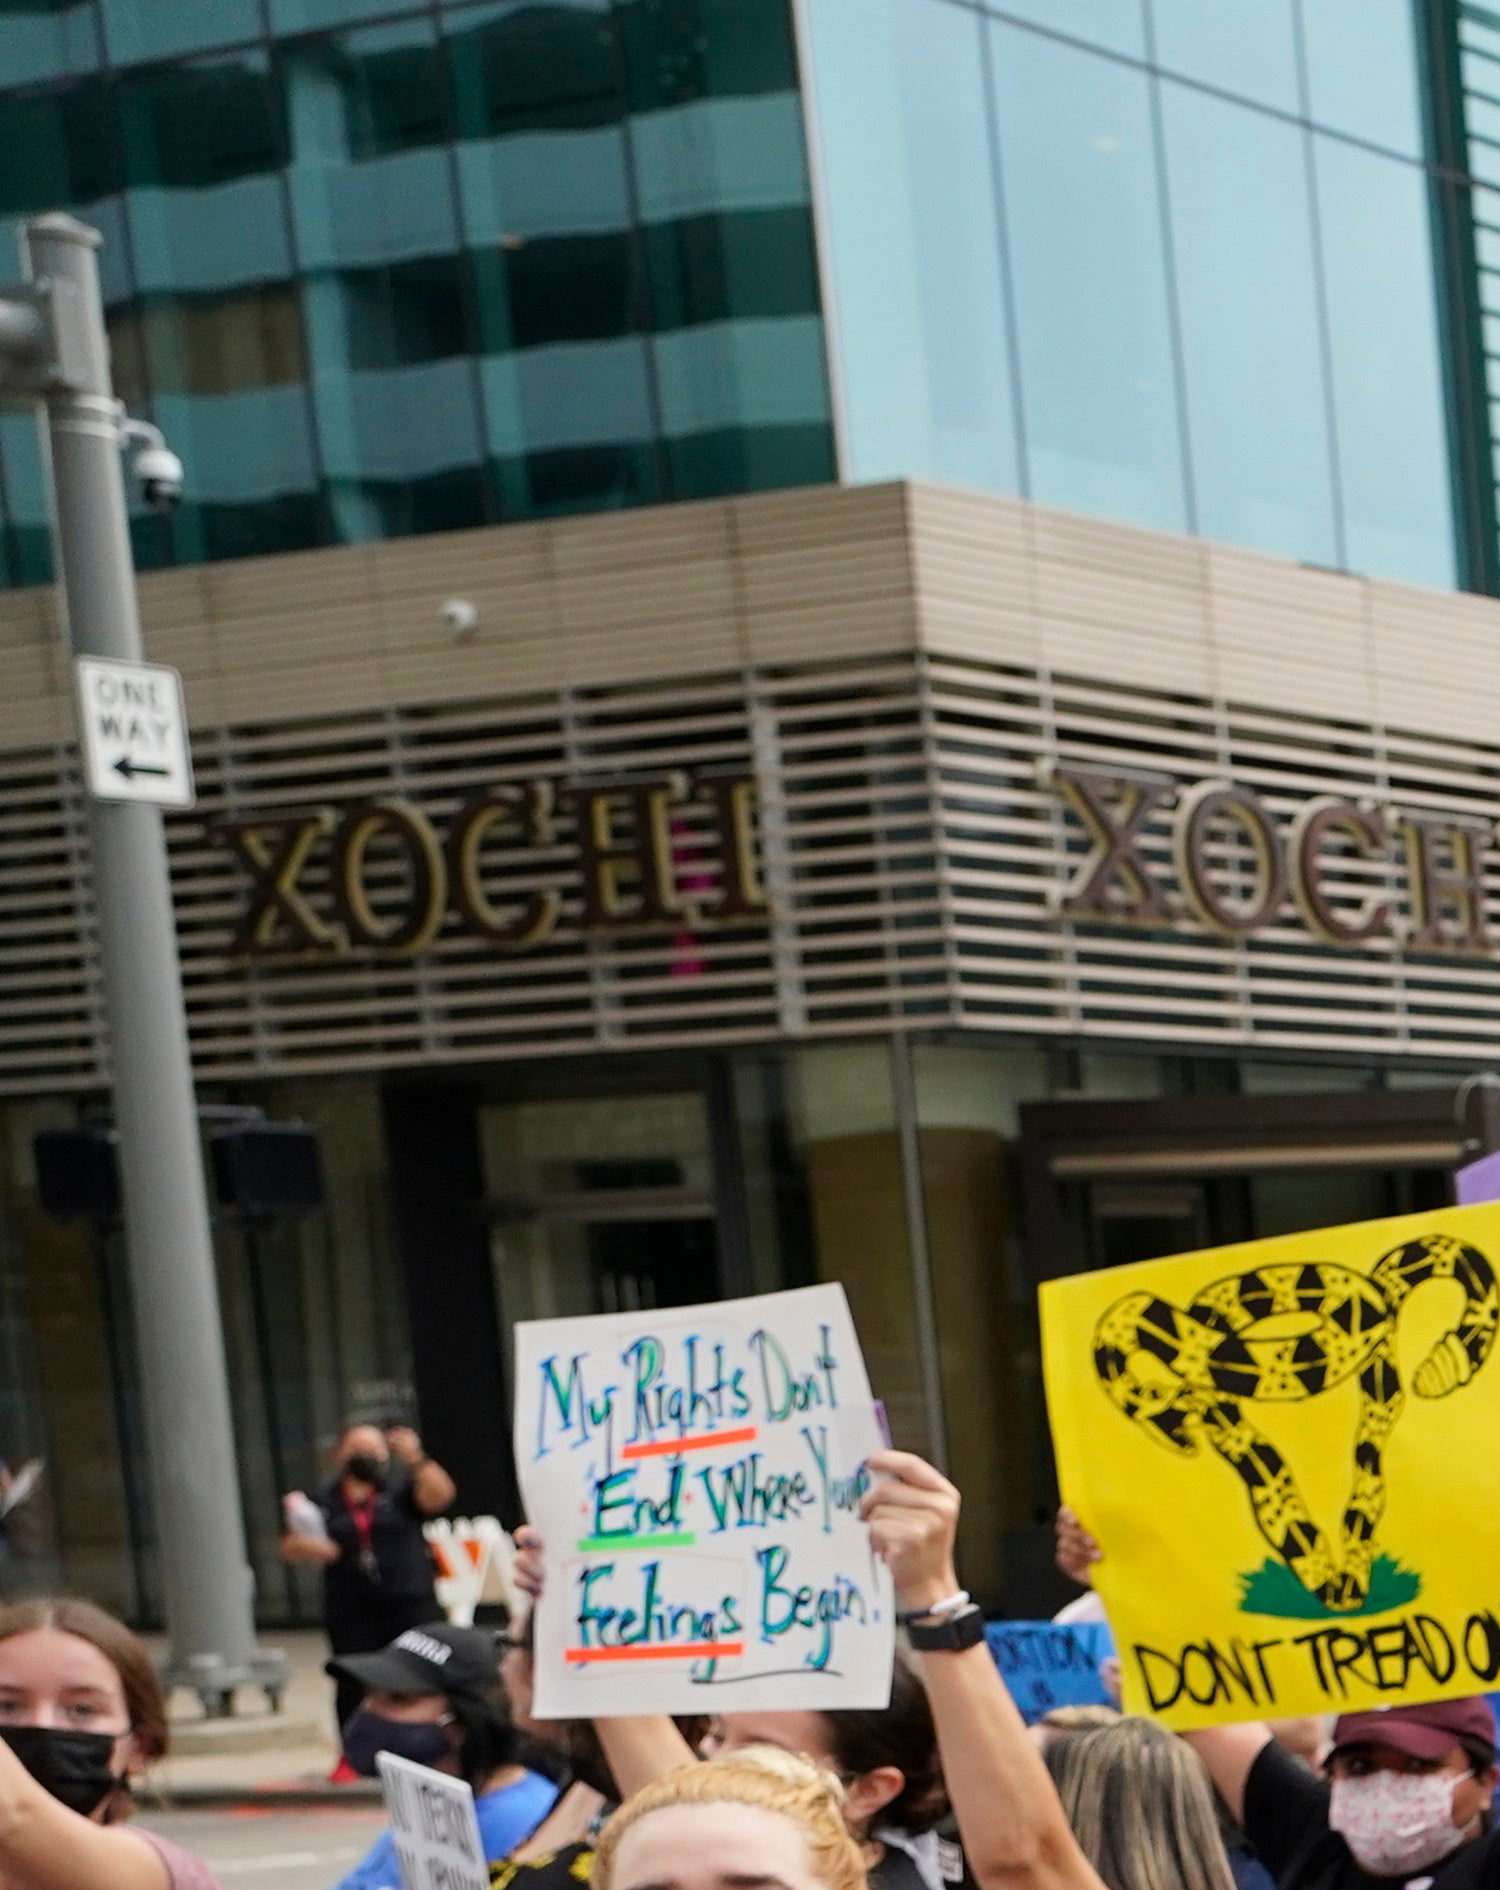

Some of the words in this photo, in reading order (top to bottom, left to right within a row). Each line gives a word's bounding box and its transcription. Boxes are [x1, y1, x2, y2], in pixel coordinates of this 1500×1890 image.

[95, 673, 169, 718] ONE
[97, 712, 173, 750] WAY
[211, 771, 773, 962] XOCHI
[534, 1351, 617, 1474] My
[621, 1334, 751, 1455] Rights
[586, 1462, 690, 1538] End
[570, 1561, 743, 1683] Feelings
[1294, 1613, 1455, 1700] TREAD
